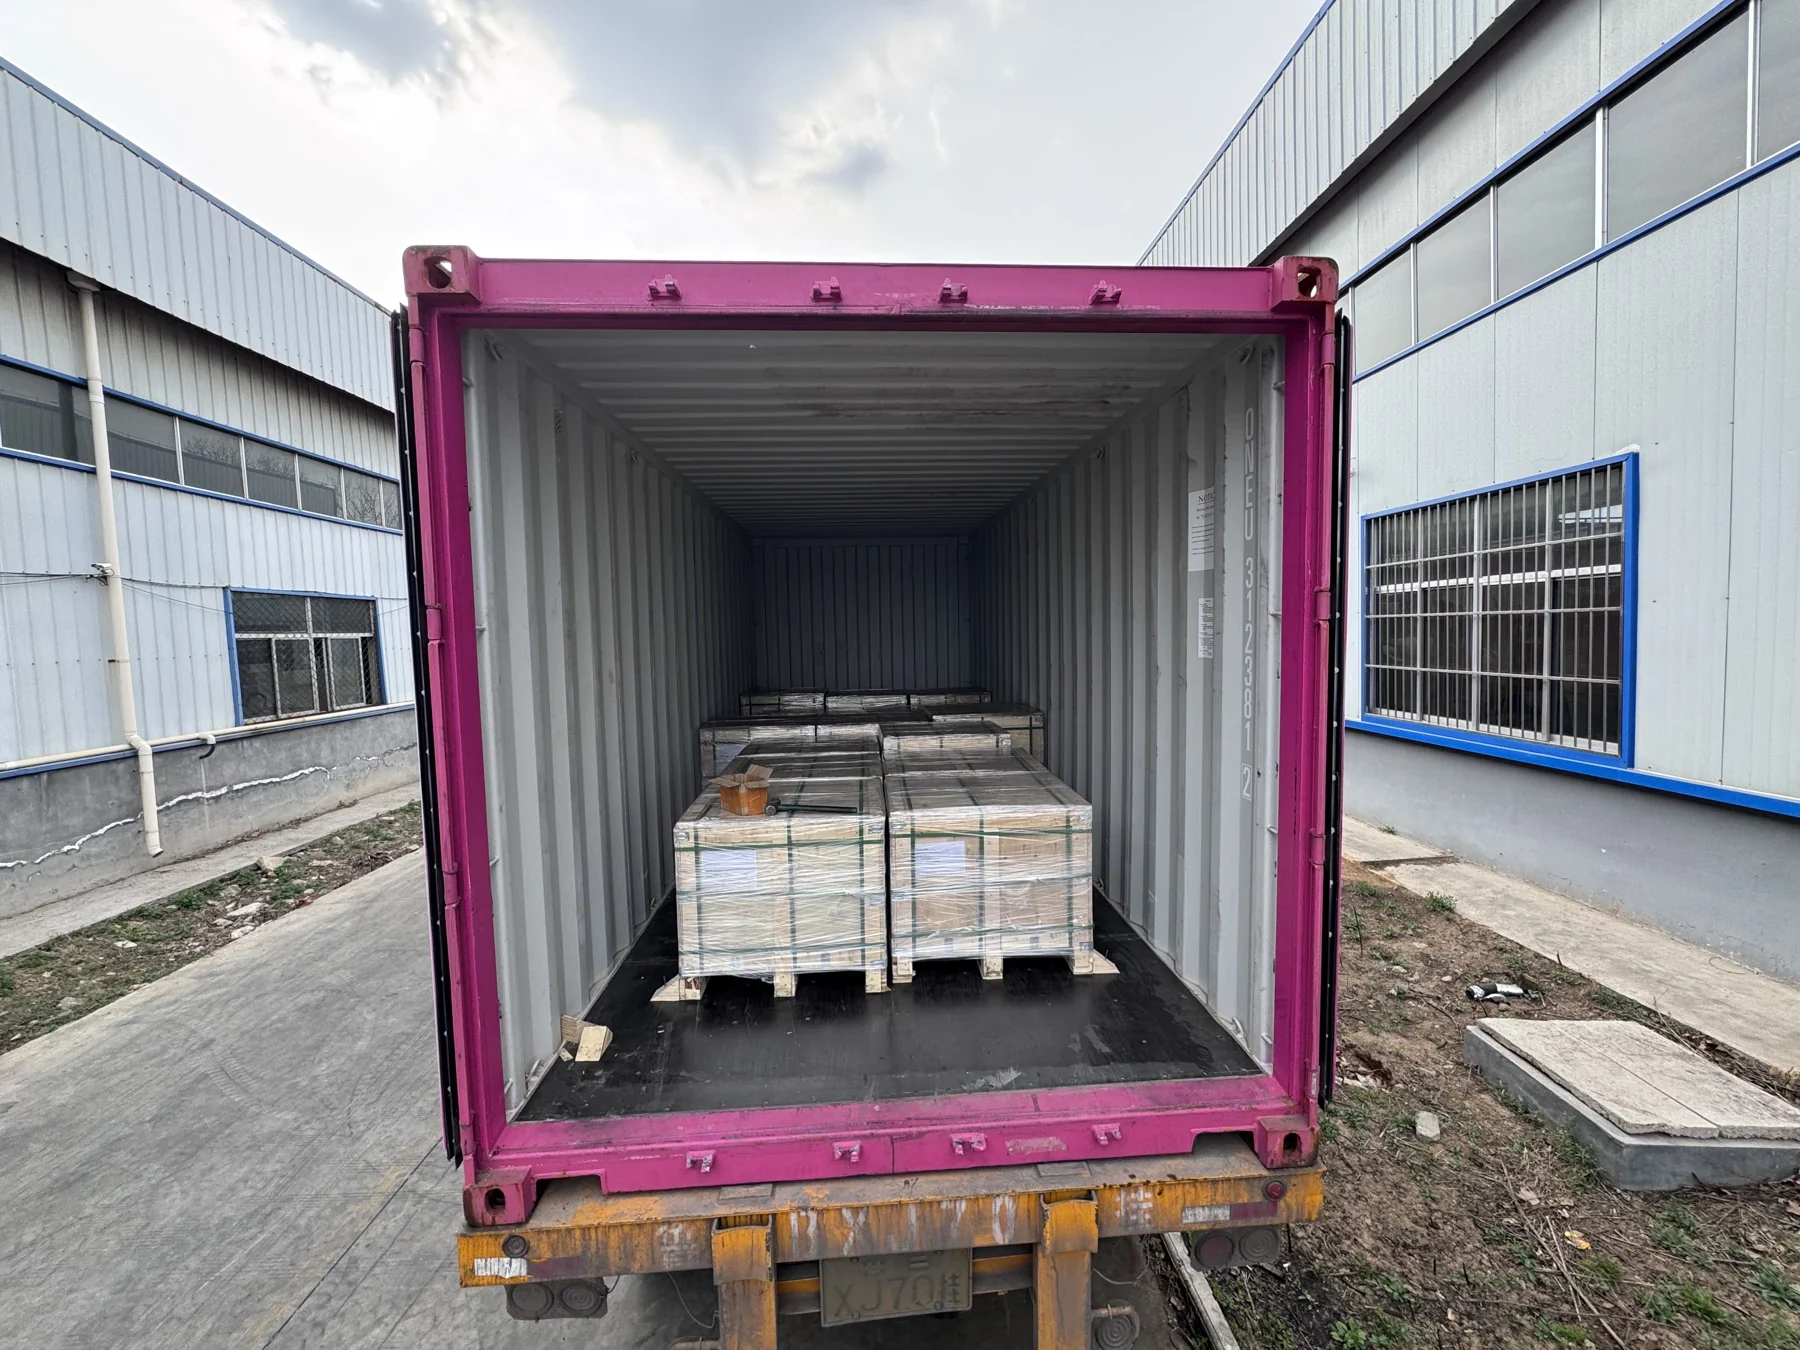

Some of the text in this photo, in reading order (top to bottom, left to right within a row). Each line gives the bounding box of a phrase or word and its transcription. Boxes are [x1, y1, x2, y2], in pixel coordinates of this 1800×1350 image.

[1242, 407, 1255, 800] ONEU 312381 2
